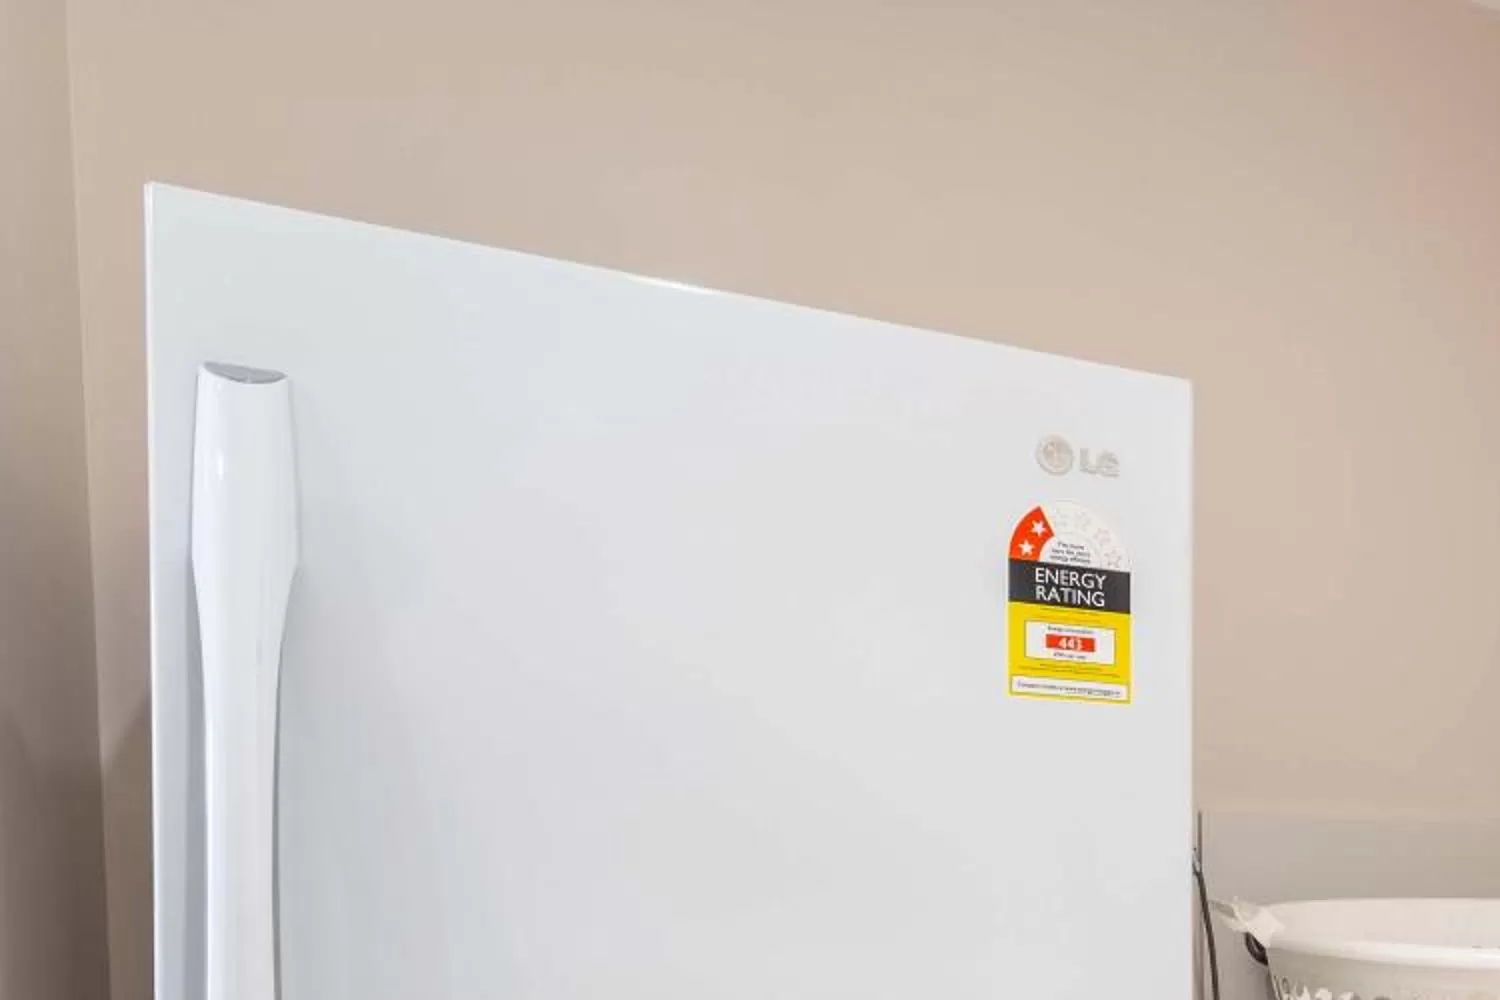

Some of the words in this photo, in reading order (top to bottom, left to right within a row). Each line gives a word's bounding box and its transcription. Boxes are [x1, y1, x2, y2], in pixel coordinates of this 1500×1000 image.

[1080, 448, 1120, 478] LG
[1034, 567, 1107, 591] ENERGY
[1035, 584, 1106, 608] RATING
